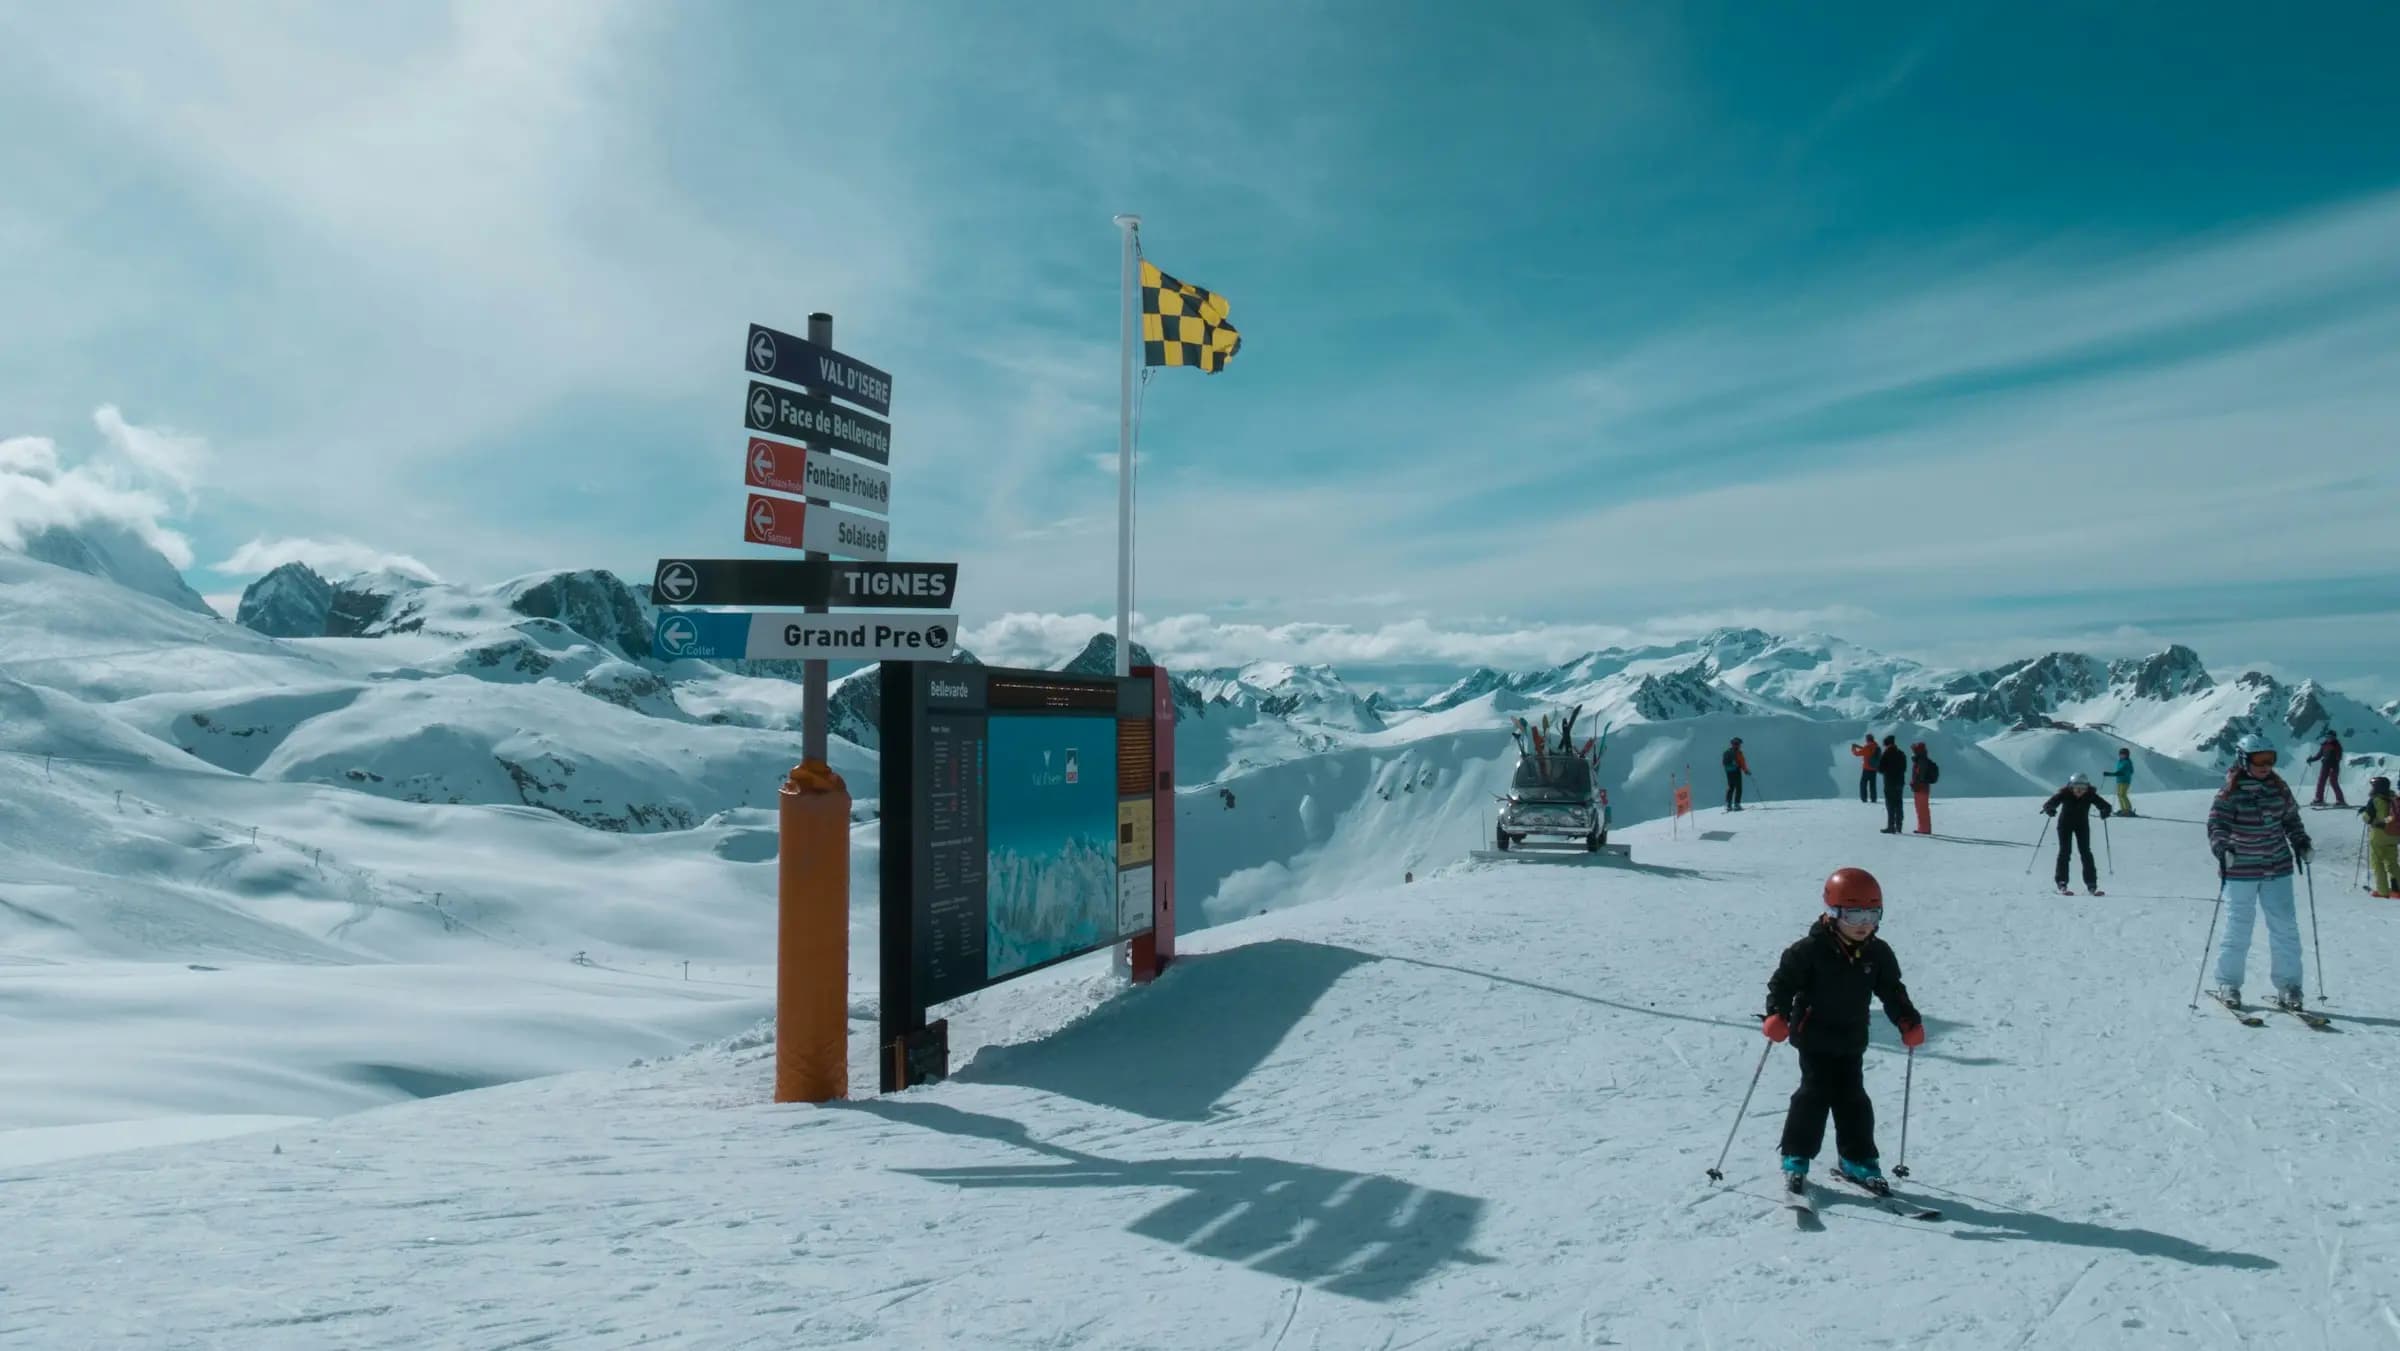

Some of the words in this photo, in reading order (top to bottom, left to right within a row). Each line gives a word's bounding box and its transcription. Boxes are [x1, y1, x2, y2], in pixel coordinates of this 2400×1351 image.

[819, 357, 845, 386] VAL
[847, 367, 889, 405] D'ISERE
[779, 399, 813, 431] Face
[815, 409, 831, 434] de
[833, 414, 888, 453] Bellevarde
[806, 461, 851, 492] Fontaine
[851, 472, 879, 499] Froide
[838, 522, 877, 550] Solaise
[845, 572, 946, 596] TIGNES
[784, 624, 865, 648] Grand
[875, 625, 921, 648] Pre
[930, 681, 969, 698] Bellevarde
